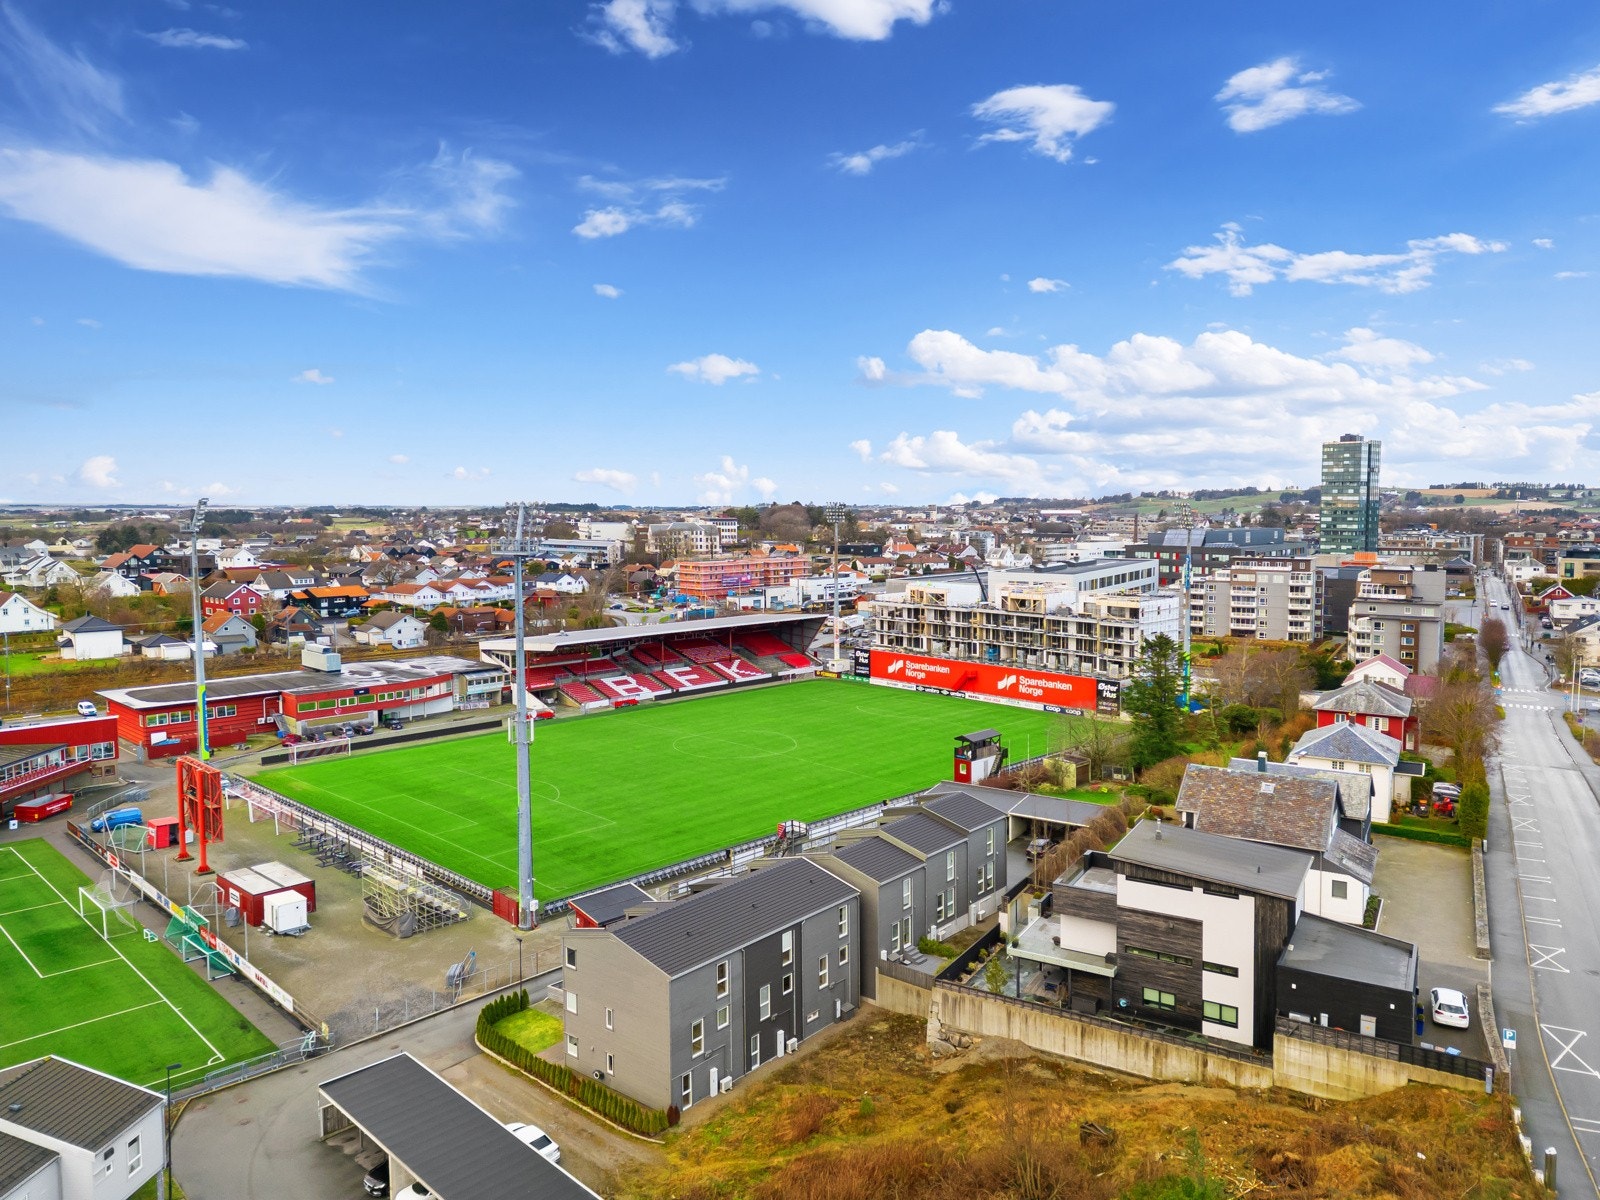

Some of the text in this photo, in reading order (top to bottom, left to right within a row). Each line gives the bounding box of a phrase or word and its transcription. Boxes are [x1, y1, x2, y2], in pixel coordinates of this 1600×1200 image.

[905, 660, 950, 674] Sparebanken
[905, 668, 926, 679] Norge
[1019, 675, 1073, 691] Sparebanken
[1098, 682, 1118, 692] Øster
[1019, 685, 1043, 696] Norge
[1103, 690, 1117, 699] Hus
[1506, 1030, 1514, 1040] P
